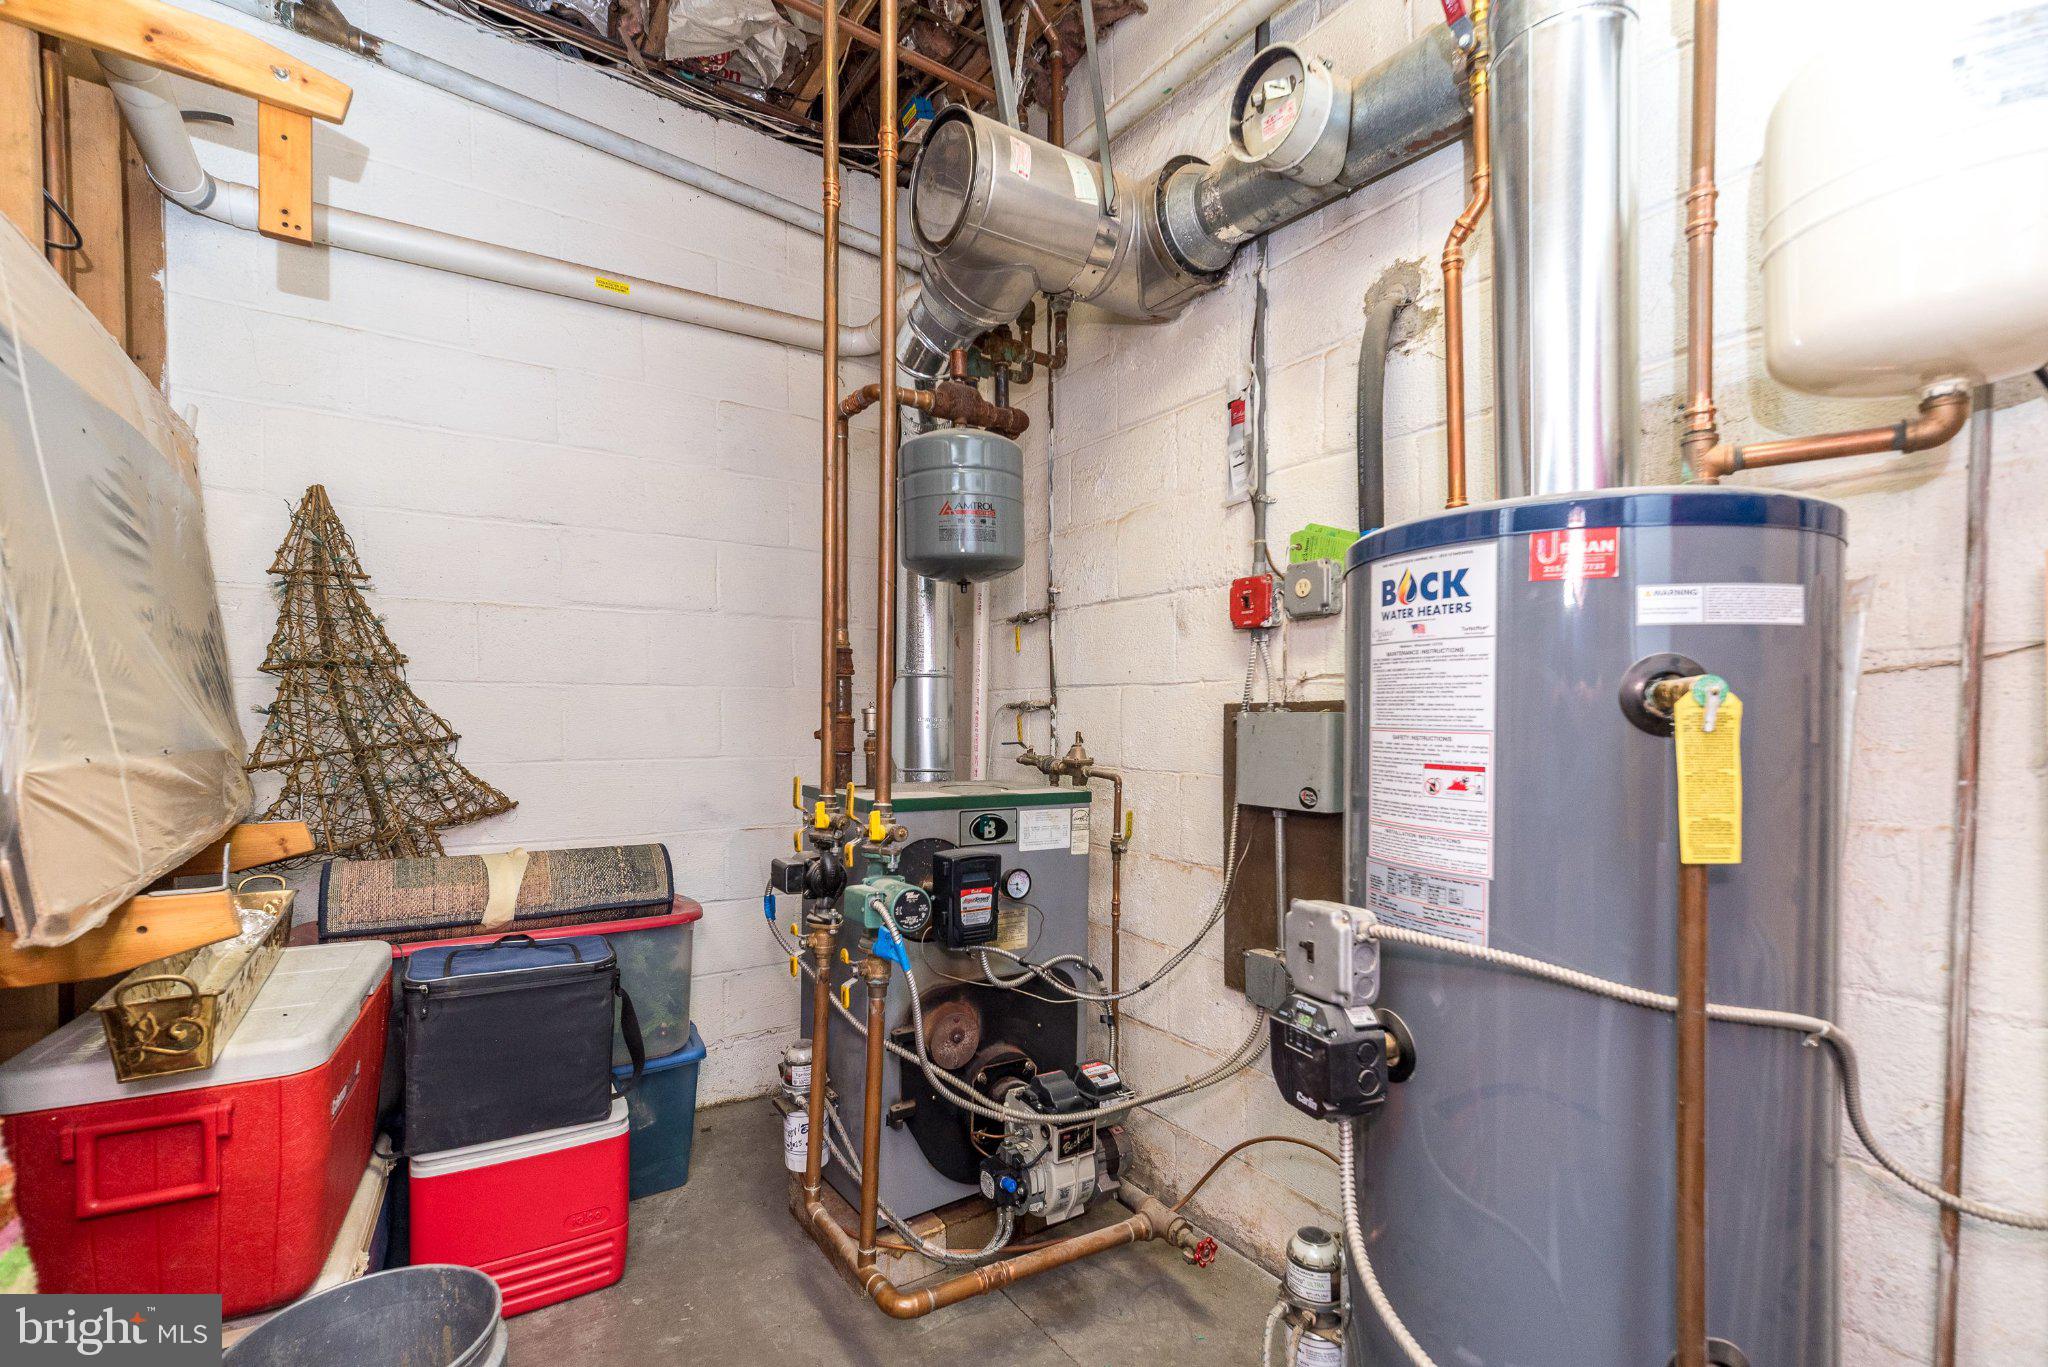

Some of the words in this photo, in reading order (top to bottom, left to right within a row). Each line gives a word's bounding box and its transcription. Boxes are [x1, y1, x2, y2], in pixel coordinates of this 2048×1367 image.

[955, 502, 995, 511] AMTROL
[1381, 608, 1414, 621] WATER
[1418, 602, 1472, 617] HEATERS
[1421, 647, 1465, 655] INSTRUCTIONS
